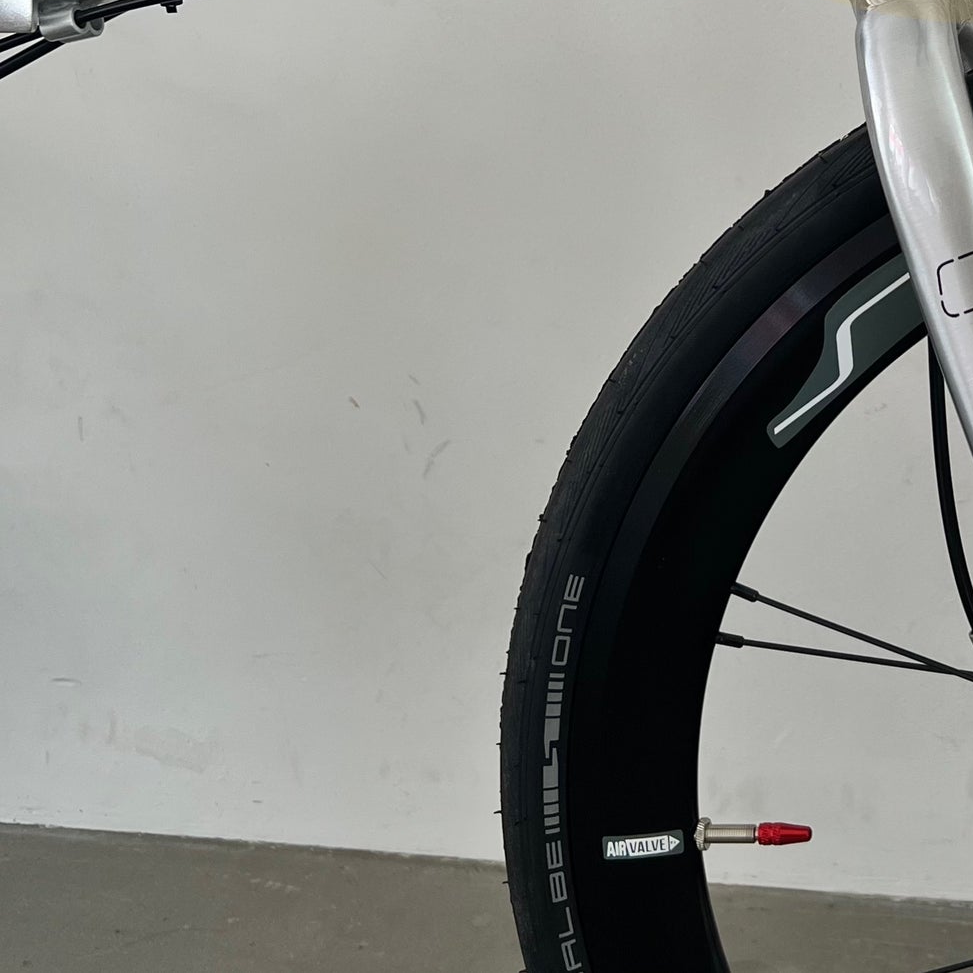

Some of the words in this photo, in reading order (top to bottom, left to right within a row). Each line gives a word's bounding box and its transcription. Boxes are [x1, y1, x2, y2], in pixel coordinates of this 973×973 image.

[551, 574, 585, 666] ONE
[606, 840, 627, 857] AIR
[628, 837, 667, 854] VALVE
[545, 840, 583, 973] ALBE
